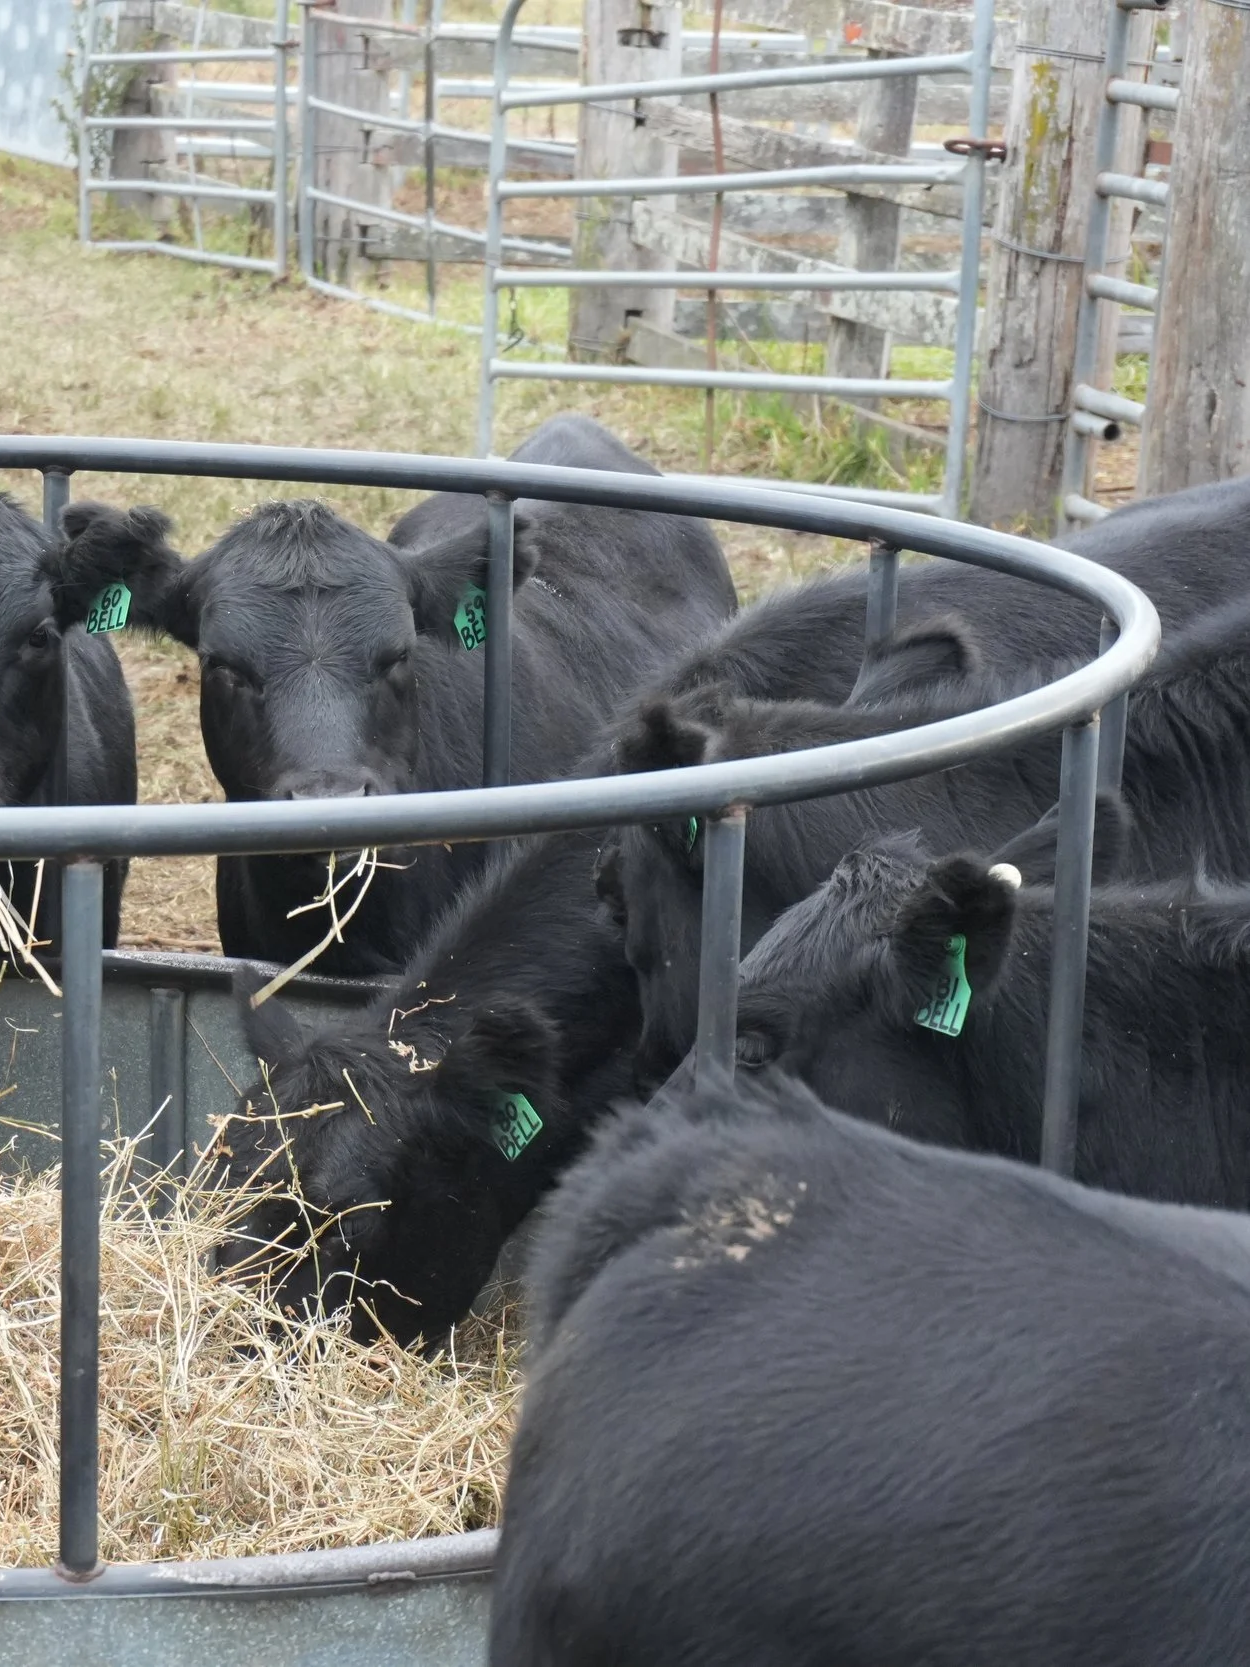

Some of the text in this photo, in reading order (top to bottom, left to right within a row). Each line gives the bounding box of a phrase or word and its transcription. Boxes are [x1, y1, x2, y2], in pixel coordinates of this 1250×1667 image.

[101, 588, 123, 610] 60
[464, 595, 487, 624] 59
[86, 606, 124, 634] BELL
[460, 615, 486, 651] BE
[499, 1110, 540, 1162] BELL
